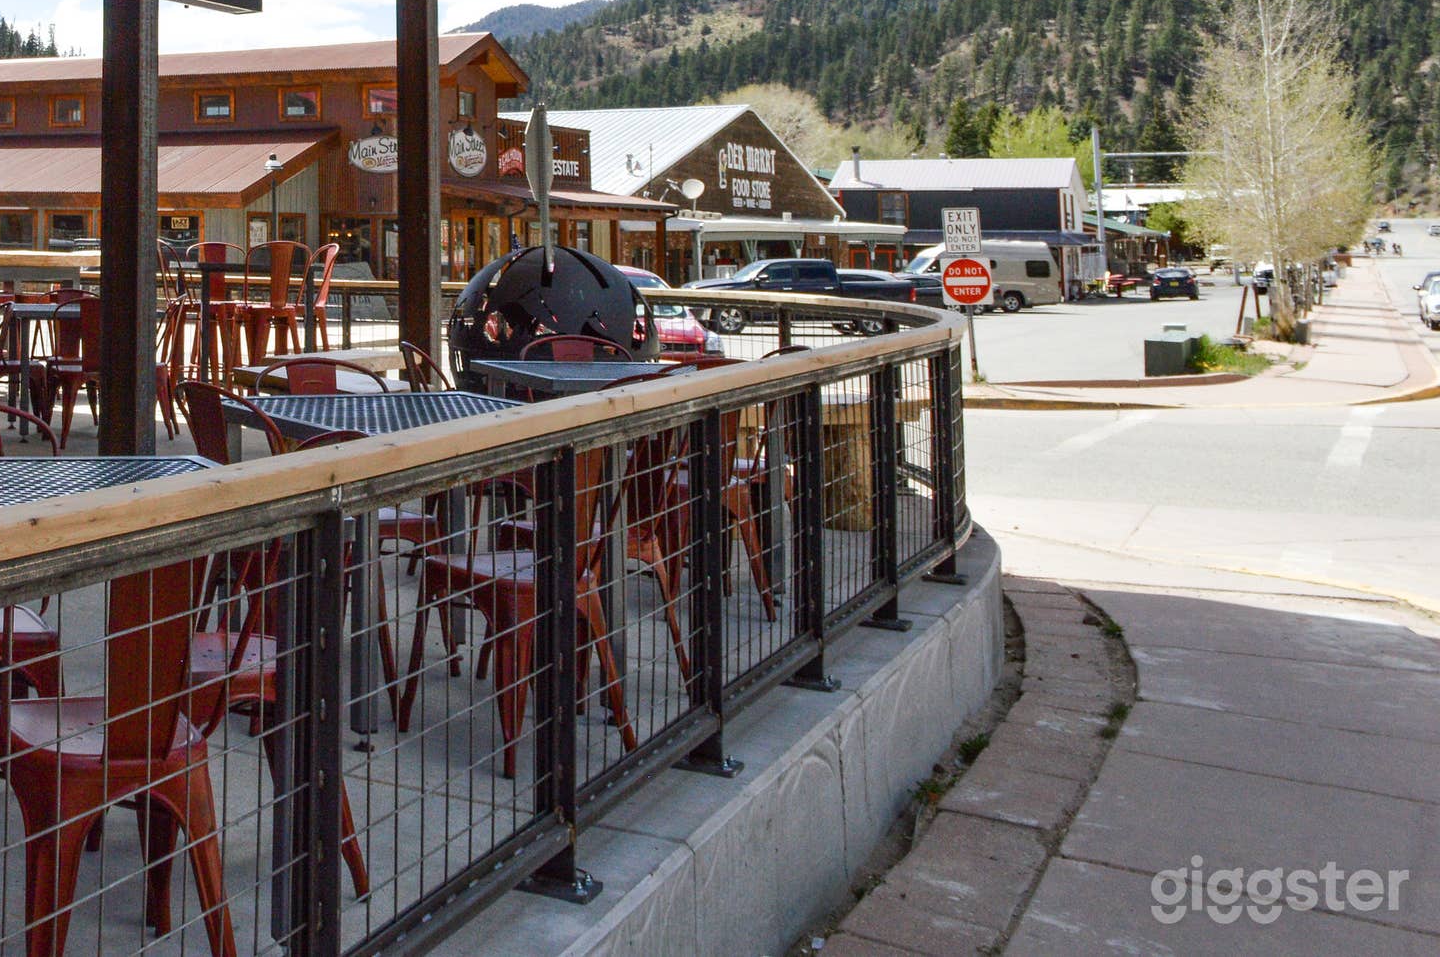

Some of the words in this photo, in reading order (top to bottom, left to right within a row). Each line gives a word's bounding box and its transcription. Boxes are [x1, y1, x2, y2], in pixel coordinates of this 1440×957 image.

[350, 140, 377, 161] Main
[379, 137, 398, 154] Str
[449, 131, 465, 158] Main
[727, 142, 745, 171] DER
[552, 159, 579, 177] ESTATE
[732, 178, 750, 197] FOOD
[751, 180, 772, 199] STORE
[948, 211, 972, 222] EXIT
[947, 224, 976, 235] ONLY
[964, 267, 982, 275] NOT
[953, 287, 981, 296] ENTER
